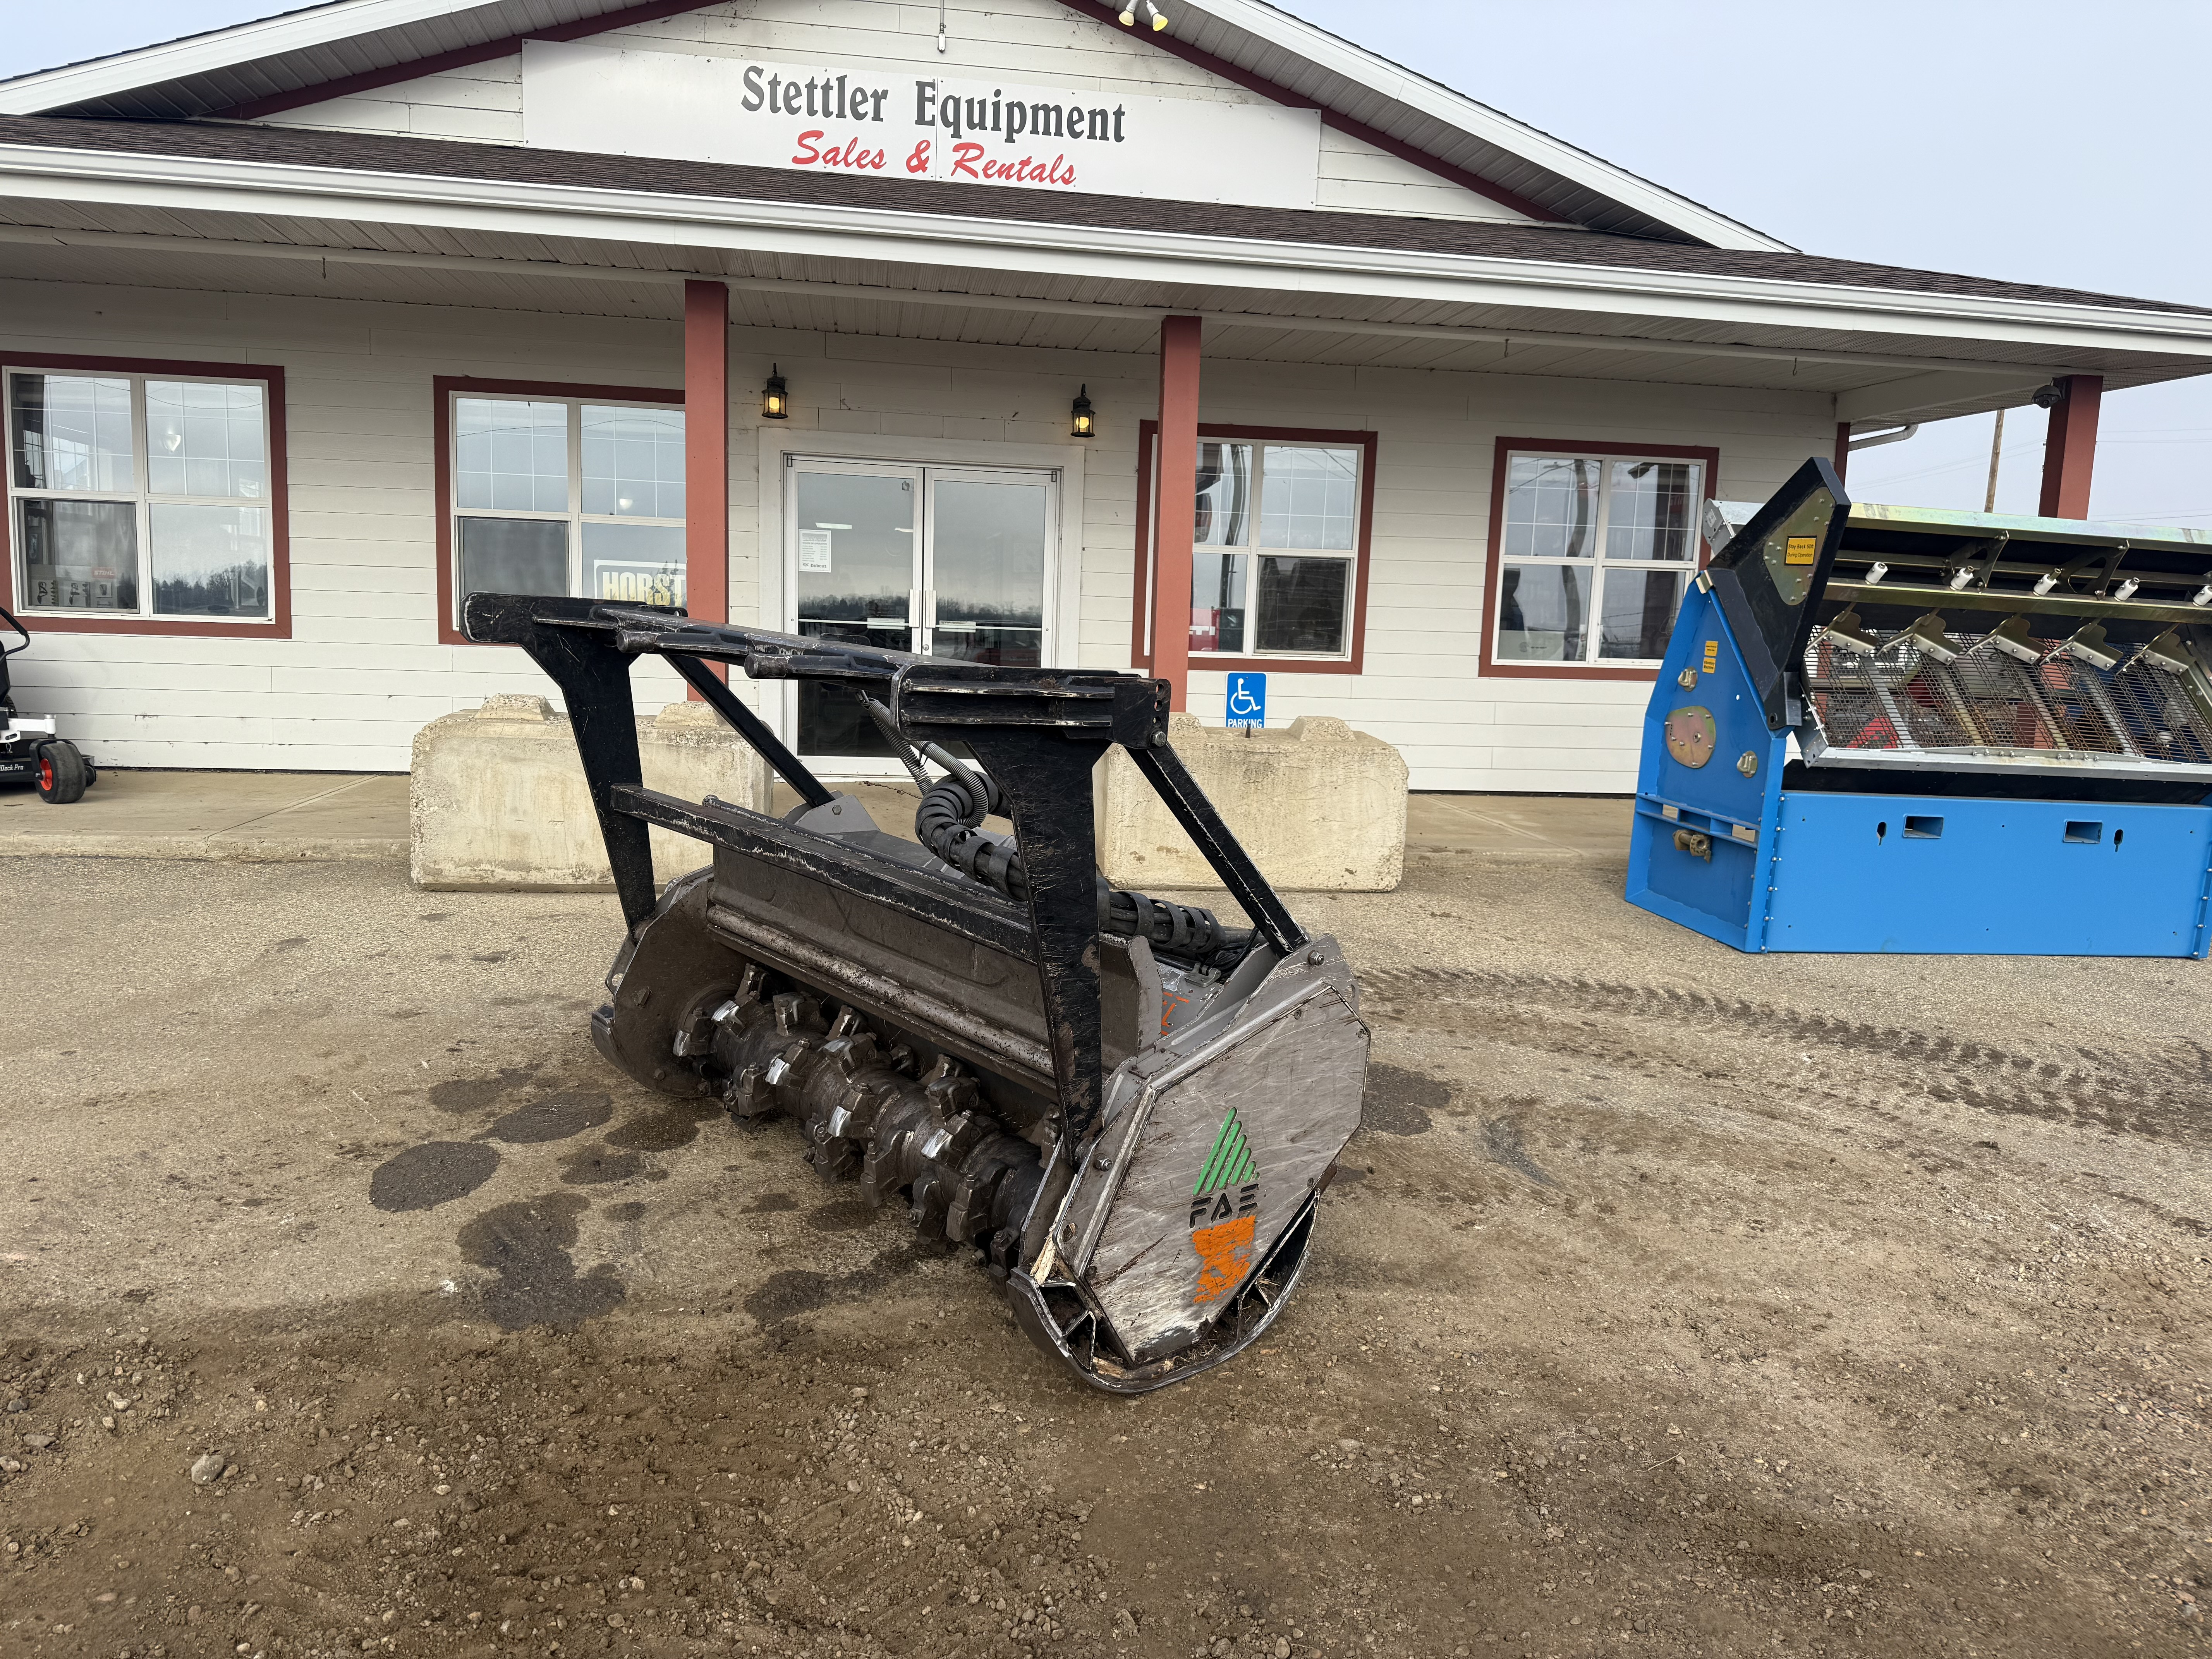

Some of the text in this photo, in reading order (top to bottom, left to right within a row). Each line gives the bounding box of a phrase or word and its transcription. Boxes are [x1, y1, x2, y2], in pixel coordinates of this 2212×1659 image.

[741, 66, 1125, 143] Stettler Equipment
[792, 131, 1076, 185] Sales & Rentals
[603, 572, 686, 607] HORST
[1189, 1183, 1259, 1228] FAE
